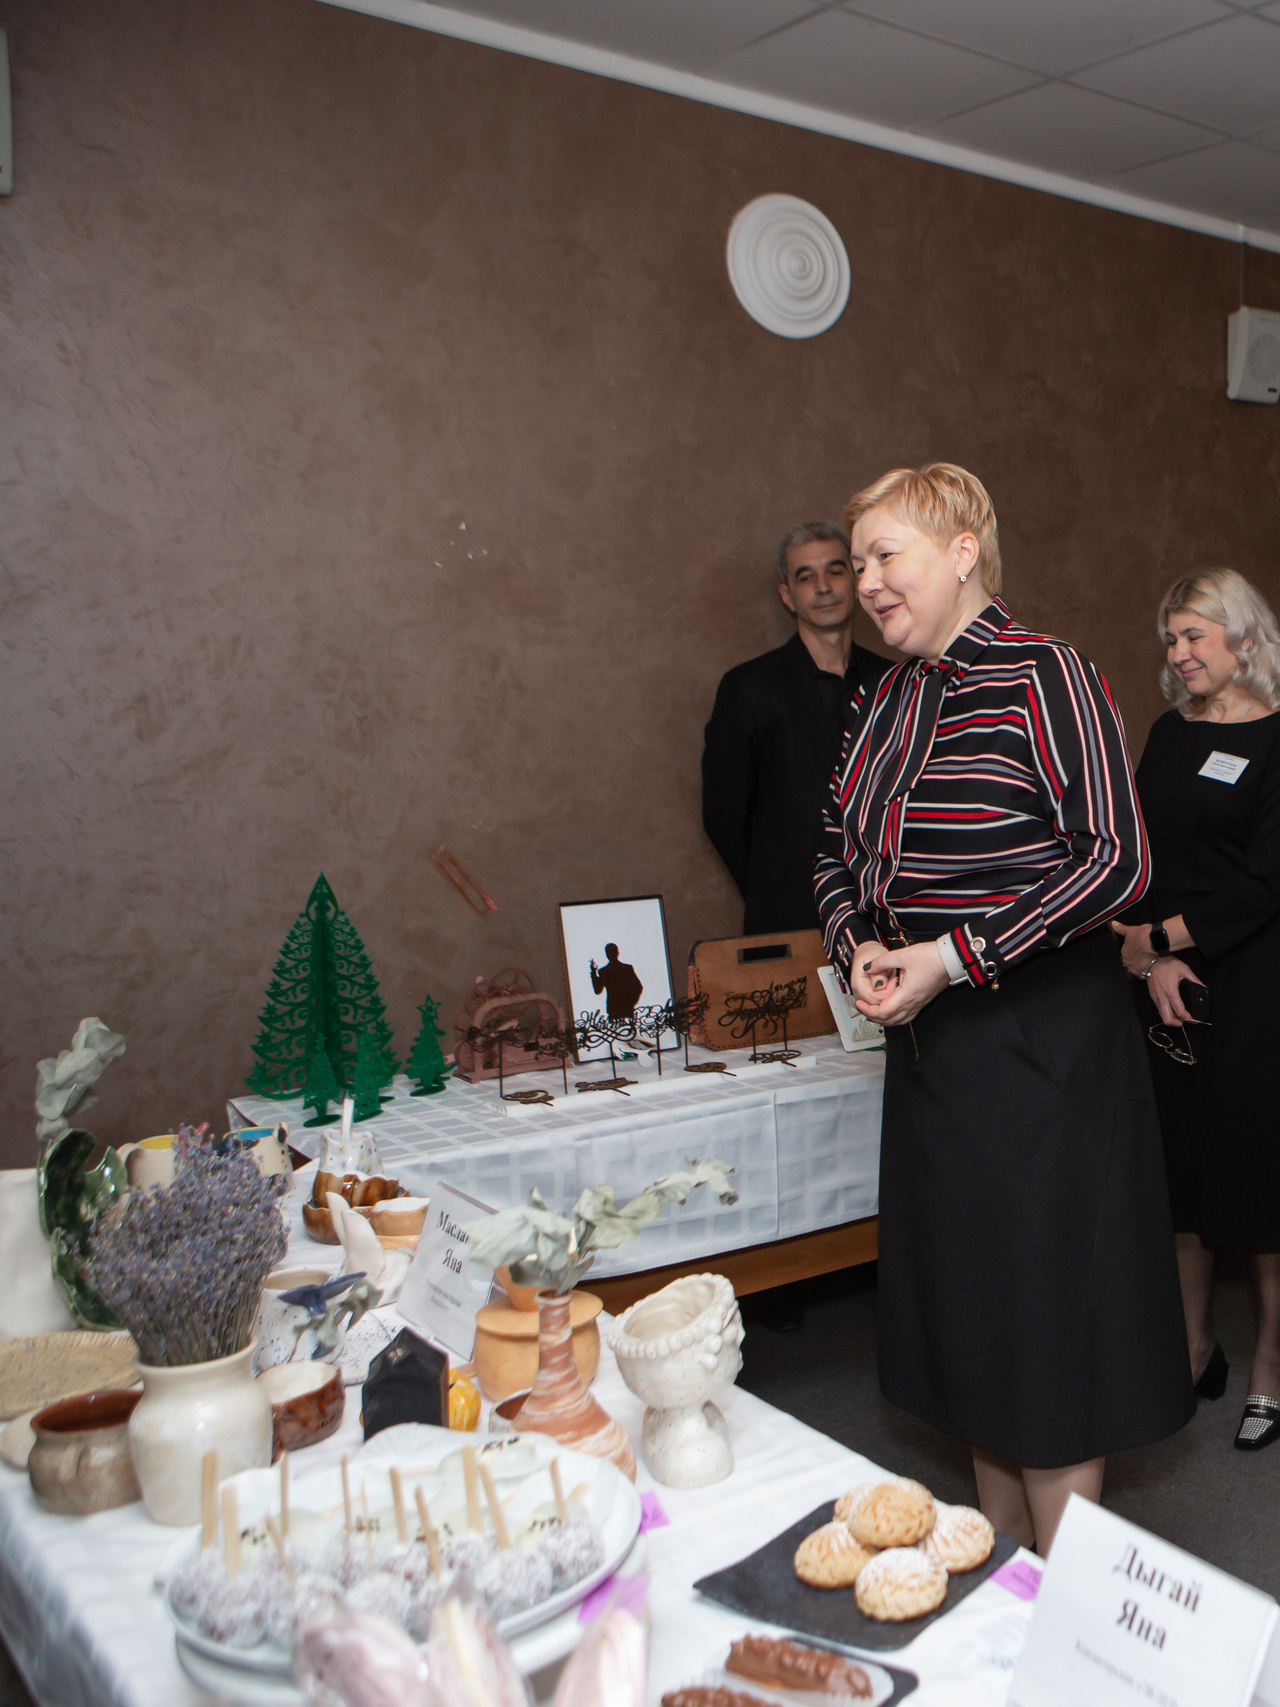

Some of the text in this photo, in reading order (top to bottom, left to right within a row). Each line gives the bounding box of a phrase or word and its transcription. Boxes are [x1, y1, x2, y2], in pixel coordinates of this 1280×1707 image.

[442, 1248, 463, 1274] Яна
[1111, 1541, 1204, 1614] Дыгай
[1115, 1598, 1168, 1651] Яна
